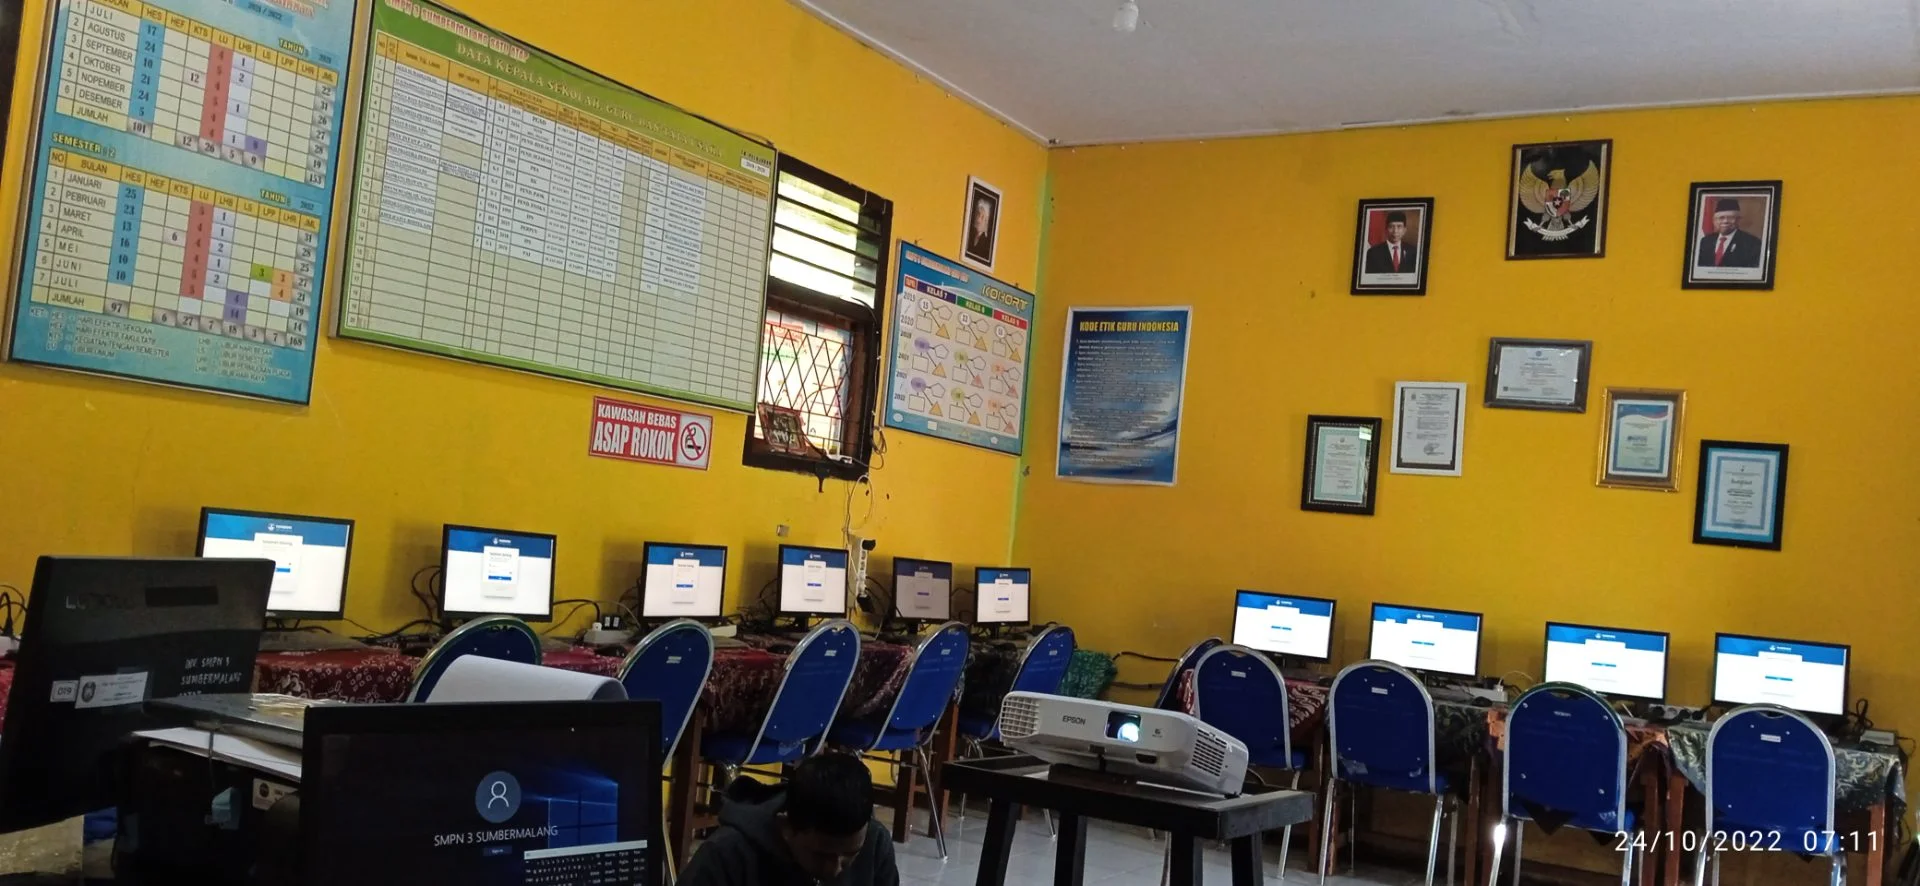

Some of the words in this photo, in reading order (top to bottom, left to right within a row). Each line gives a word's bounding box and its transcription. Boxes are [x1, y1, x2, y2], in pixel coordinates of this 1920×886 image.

[89, 5, 113, 20] JULI
[146, 24, 157, 36] 17
[146, 8, 162, 18] HES
[171, 16, 185, 27] HEF
[194, 23, 208, 34] KTS
[218, 35, 229, 44] LU
[71, 34, 77, 43] 3
[85, 39, 133, 62] SEPTEMBER
[143, 57, 153, 69] 10
[190, 72, 200, 84] 12
[279, 38, 305, 55] TAHUN
[73, 18, 79, 27] 2
[87, 22, 126, 42] AGUSTUS
[144, 41, 156, 53] 24
[238, 73, 245, 83] 2
[320, 100, 328, 112] 31
[83, 55, 121, 76] OKTOBER
[140, 73, 151, 85] 21
[457, 42, 493, 67] DATA
[496, 59, 544, 87] KEPALA
[66, 68, 72, 77] 5
[81, 72, 126, 93] NOPEMBER
[137, 90, 149, 102] 24
[64, 84, 70, 94] 6
[79, 88, 122, 110] DESEMBER
[138, 107, 145, 117] 5
[52, 132, 101, 153] SEMESTER
[76, 106, 109, 123] JUMLAH
[132, 121, 146, 134] 101
[182, 135, 192, 147] 12
[309, 173, 322, 185] 153
[51, 151, 65, 163] NO
[81, 159, 108, 174] BULAN
[125, 172, 141, 183] HES
[150, 178, 165, 188] HEF
[173, 183, 188, 195] KTS
[199, 190, 209, 200] LU
[219, 195, 233, 207] LHB
[50, 186, 57, 196] 2
[65, 190, 107, 207] PEBRUARI
[123, 204, 135, 216] 23
[68, 172, 102, 190] JANUARI
[125, 187, 137, 199] 25
[304, 232, 312, 243] 31
[48, 204, 54, 213] 3
[63, 207, 92, 222] MARET
[122, 220, 132, 232] 13
[171, 232, 178, 241] 6
[217, 243, 224, 253] 2
[299, 263, 310, 273] 25
[60, 224, 84, 238] APRIL
[120, 237, 130, 248] 16
[41, 255, 47, 265] 6
[55, 259, 82, 272] JUNI
[116, 270, 126, 281] 10
[44, 238, 50, 248] 5
[59, 241, 79, 254] MEI
[118, 254, 128, 265] 10
[213, 274, 220, 284] 2
[54, 276, 78, 289] JULI
[926, 284, 944, 297] KELAS
[52, 293, 85, 307] JUMLAH
[111, 301, 123, 314] 97
[161, 312, 168, 322] 6
[182, 316, 193, 326] 27
[900, 314, 914, 327] 2020
[123, 322, 153, 334] SEKOLAH
[1080, 321, 1099, 332] KODE
[1100, 321, 1116, 332] ETIK
[1117, 321, 1137, 332] GURU
[1138, 321, 1179, 332] INDONESIA
[597, 403, 646, 424] KAWASAN
[647, 412, 677, 429] BEBAS
[592, 421, 630, 455] ASAP
[630, 426, 676, 461] ROKOK
[1062, 714, 1087, 725] EPSON
[434, 833, 464, 847] SMPN
[467, 832, 473, 844] 3
[475, 825, 559, 843] SUMBERMALANG
